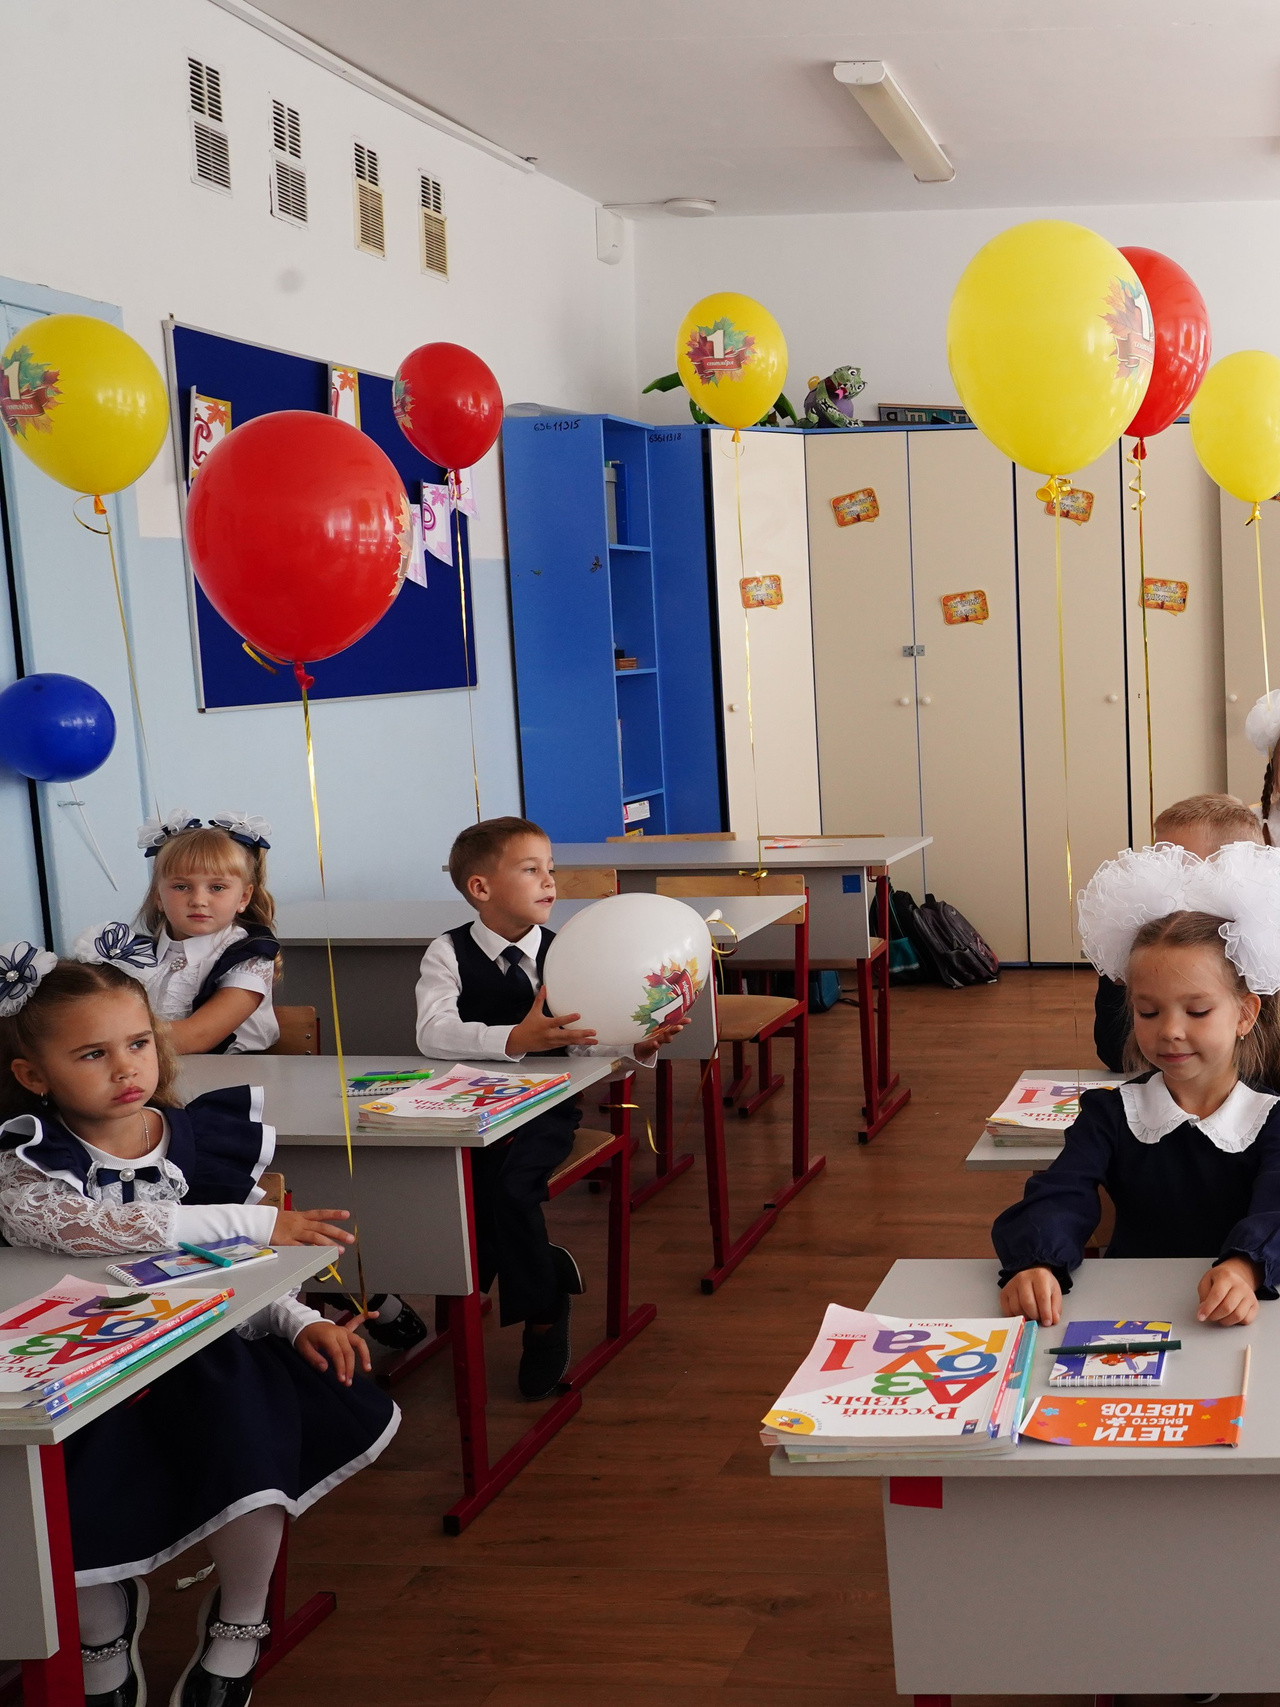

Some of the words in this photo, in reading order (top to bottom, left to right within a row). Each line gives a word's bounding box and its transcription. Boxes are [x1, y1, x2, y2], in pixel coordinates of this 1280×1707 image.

[707, 330, 724, 358] 1
[4, 361, 20, 399] 1
[1017, 1088, 1045, 1104] 1
[0, 1299, 75, 1331] 1
[819, 1338, 867, 1372] 1
[841, 1404, 961, 1420] Русский
[1101, 1403, 1194, 1417] ЦВЕТОВ
[1131, 1417, 1184, 1425] ВМЕСТО
[1093, 1425, 1189, 1442] ДЕТИ
